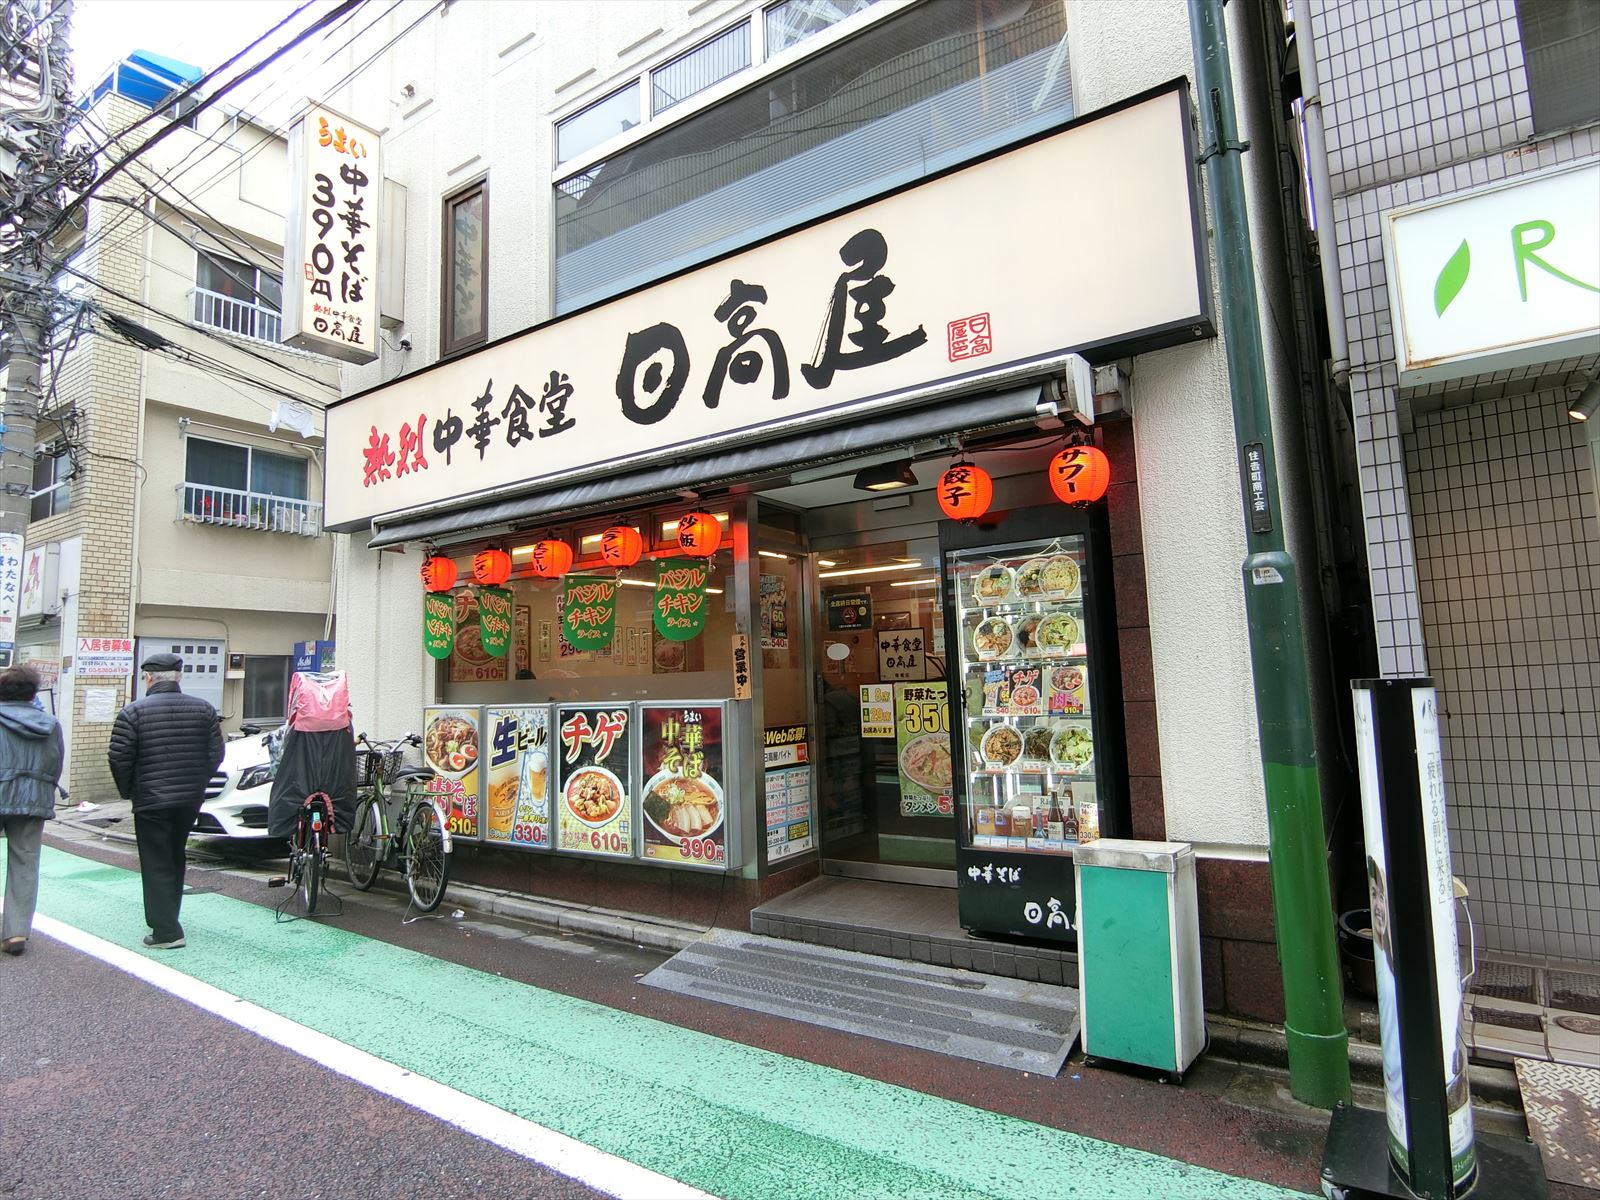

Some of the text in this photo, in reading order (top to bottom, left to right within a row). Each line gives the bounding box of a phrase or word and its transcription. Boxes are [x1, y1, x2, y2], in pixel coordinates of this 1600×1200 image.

[318, 117, 367, 159] うまい
[310, 173, 336, 302] 390円
[337, 164, 371, 304] 中華そば
[313, 317, 365, 345] 日高屋
[615, 228, 928, 425] 日高屋
[1058, 449, 1089, 493] サワー
[1248, 450, 1265, 512] 住吉町商工会
[943, 468, 972, 507] 餃子
[679, 514, 699, 549] 炒飯
[3, 556, 19, 603] わたなべ
[657, 567, 706, 593] バジル
[567, 583, 614, 606] バジル
[658, 592, 704, 618] チキン
[567, 606, 613, 630] チキン
[80, 638, 132, 652] 入居者募集
[880, 635, 923, 653] 中華食堂
[886, 654, 917, 668] 日高屋
[1012, 669, 1040, 688] チゲ
[903, 688, 948, 701] 野菜たっ
[684, 710, 702, 723] うまい
[561, 709, 628, 765] チゲ
[514, 824, 548, 843] 330円
[590, 831, 629, 852] 610円
[679, 836, 725, 862] 390円
[967, 863, 1022, 884] 中華そば
[1024, 896, 1077, 931] 日高
